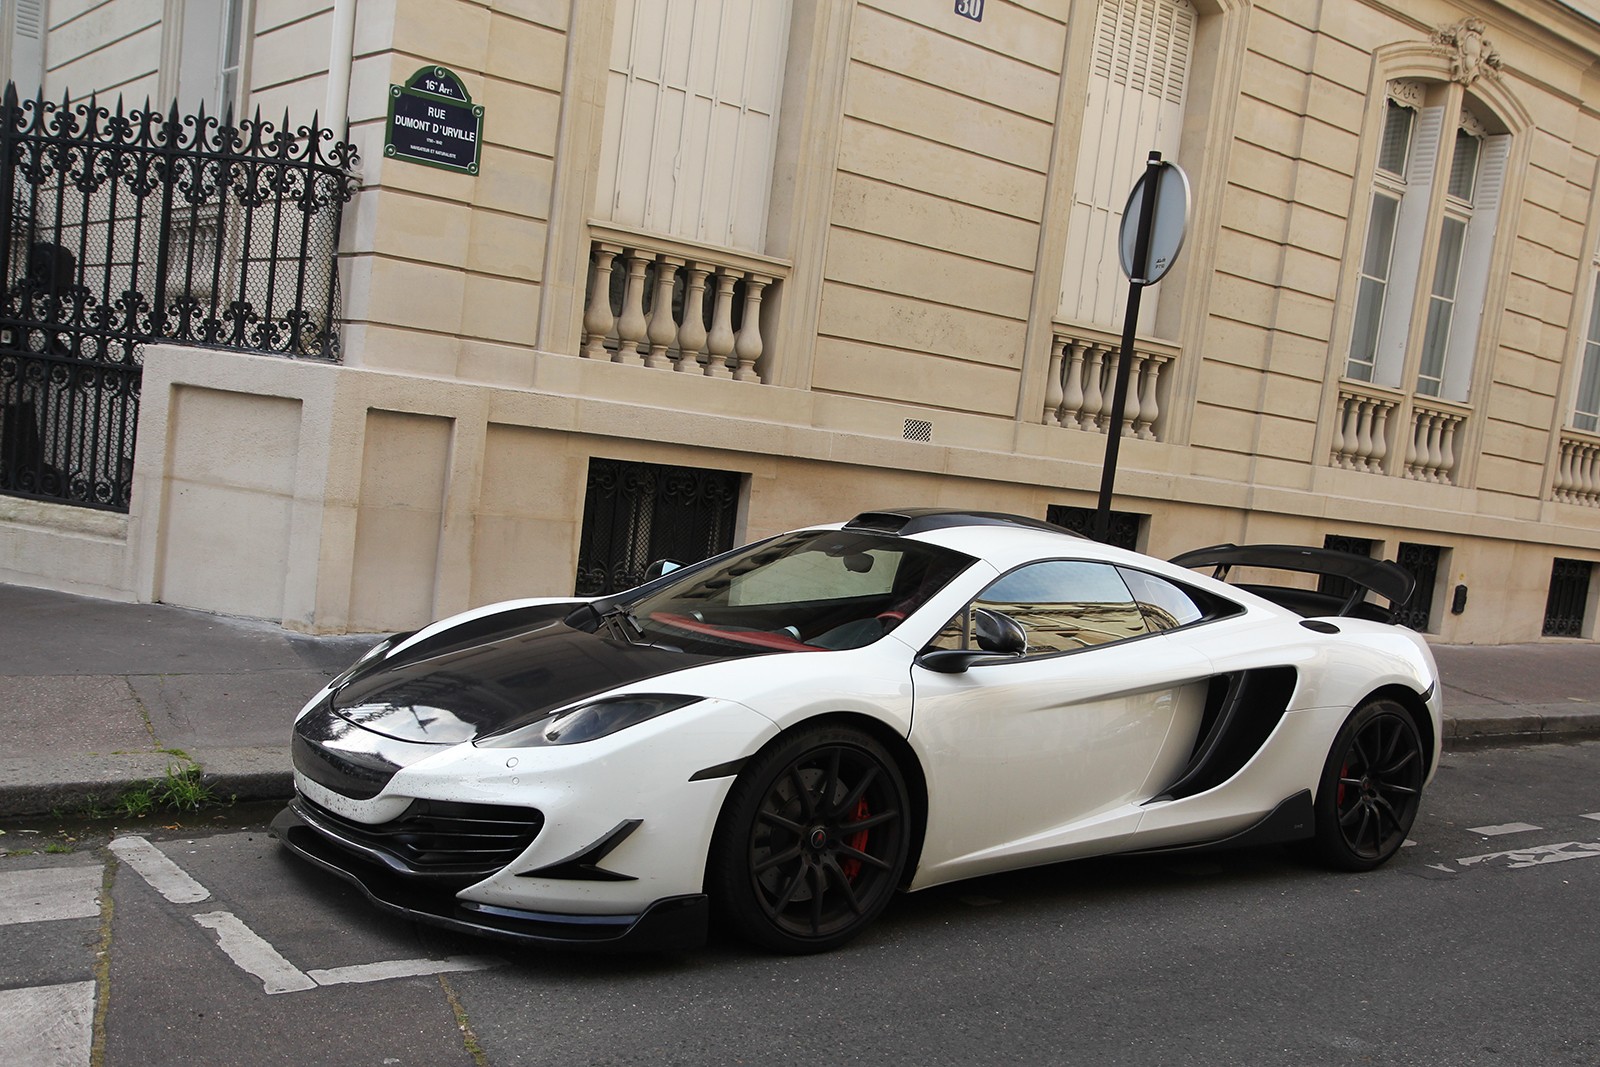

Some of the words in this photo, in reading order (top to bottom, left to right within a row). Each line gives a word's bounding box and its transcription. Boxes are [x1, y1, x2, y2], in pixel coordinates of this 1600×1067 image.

[958, 0, 980, 18] 30
[428, 106, 446, 120] RUE
[395, 115, 431, 132] DUMONT
[432, 123, 475, 142] D'URVILLE
